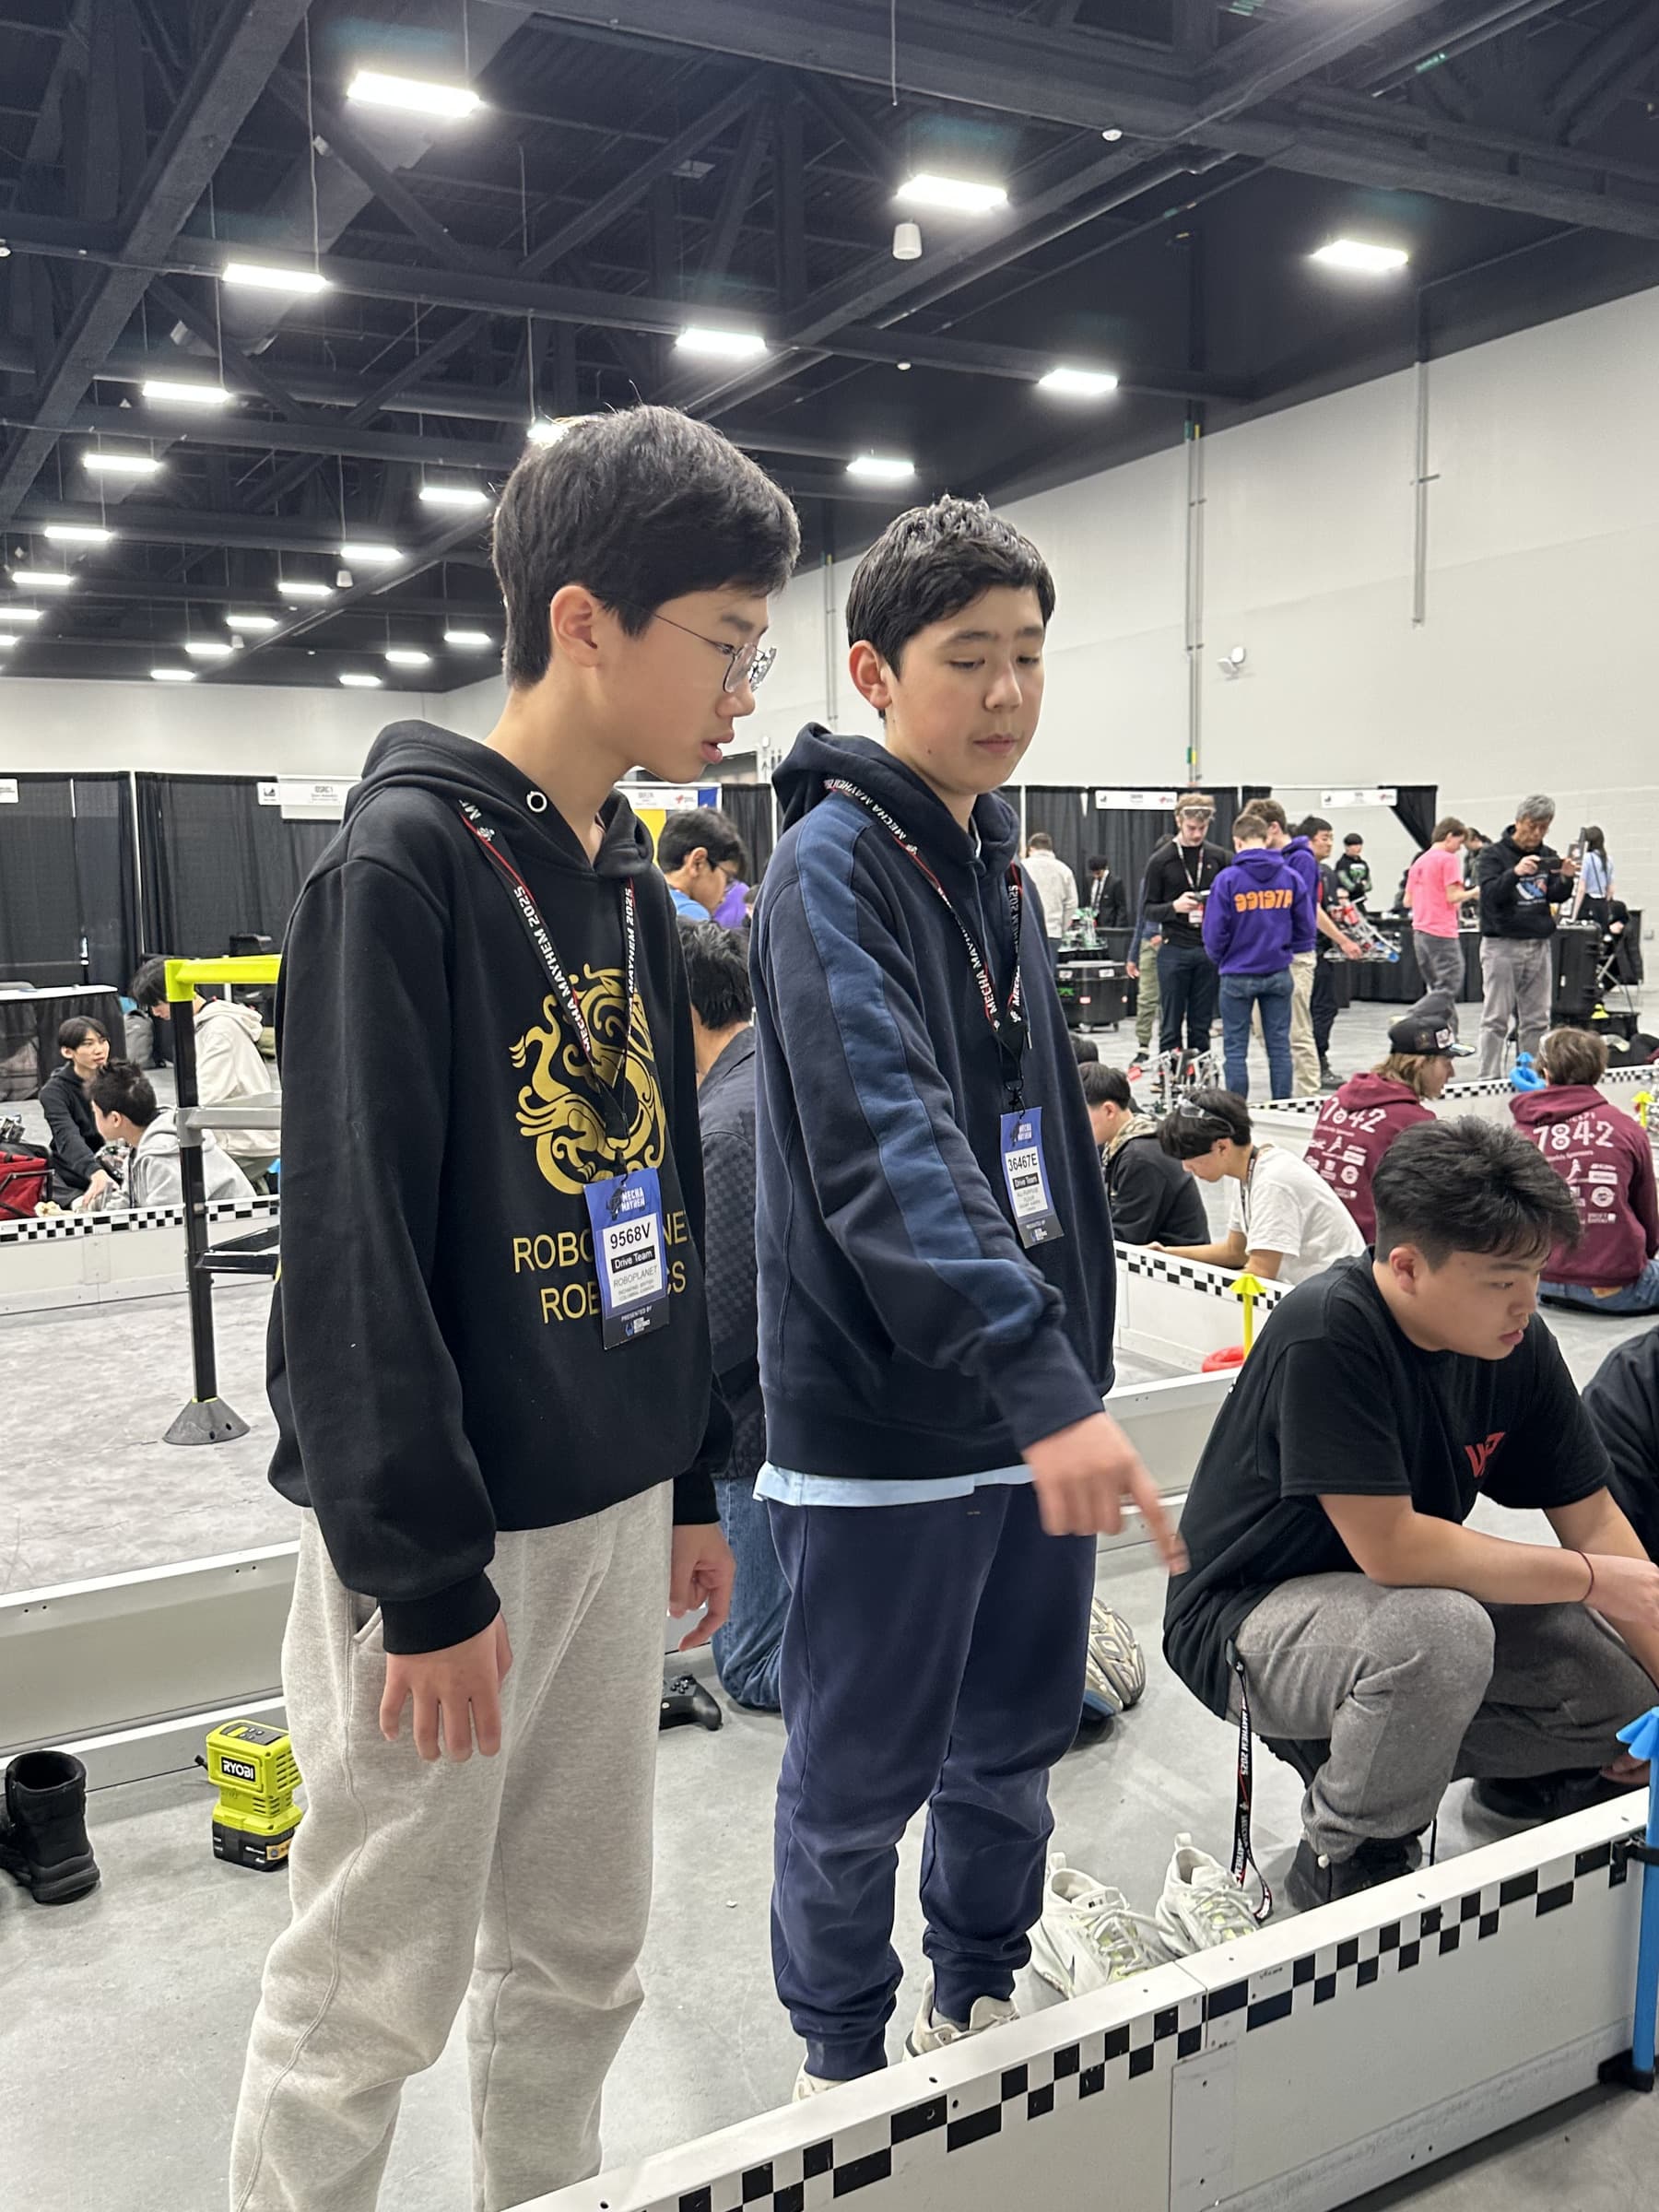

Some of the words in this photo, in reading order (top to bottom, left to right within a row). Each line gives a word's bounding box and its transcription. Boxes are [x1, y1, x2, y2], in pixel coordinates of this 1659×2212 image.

[513, 886, 540, 928] 2025
[624, 888, 636, 926] 2025
[1234, 888, 1294, 912] 99197A
[534, 928, 571, 997] MAYHEM
[627, 927, 636, 994] MAYHEM
[975, 970, 997, 1016] MECHA
[568, 997, 591, 1052] MECHA
[1533, 1121, 1614, 1153] 7842
[1007, 1153, 1038, 1171] 36467E
[620, 1198, 645, 1212] MAYHEM
[621, 1187, 644, 1202] MECHA
[610, 1222, 651, 1249] 9568V
[614, 1256, 632, 1269] Drive
[633, 1250, 653, 1263] Team
[613, 1265, 657, 1288] ROBOPLANET
[222, 1759, 254, 1780] RYOBI
[1240, 1751, 1249, 1775] 2025
